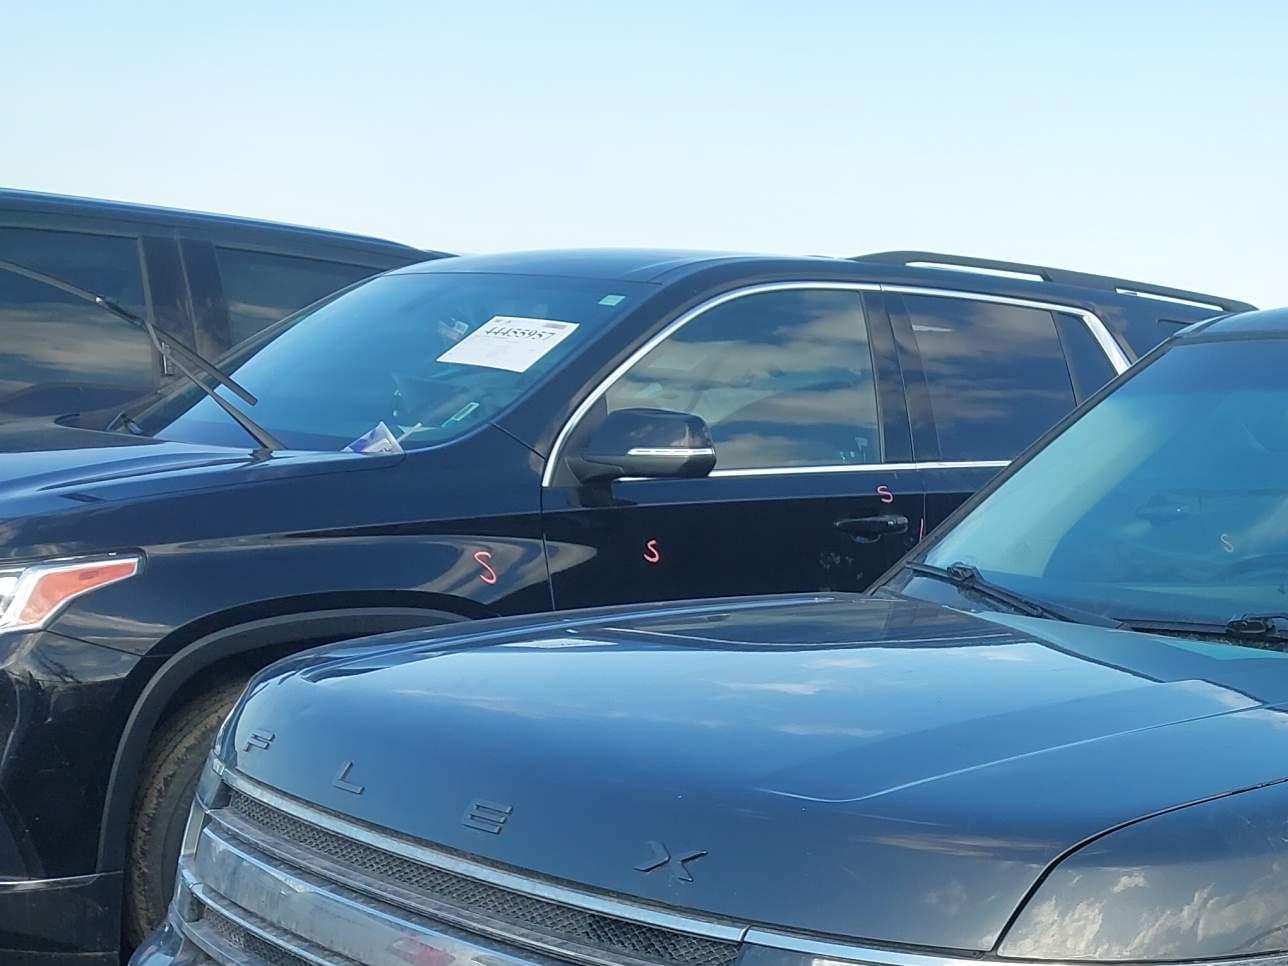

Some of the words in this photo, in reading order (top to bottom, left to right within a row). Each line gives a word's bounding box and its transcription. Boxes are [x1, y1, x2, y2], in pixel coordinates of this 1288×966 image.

[485, 326, 556, 340] 44455957
[877, 485, 893, 504] S
[643, 539, 660, 563] S
[473, 551, 497, 584] S
